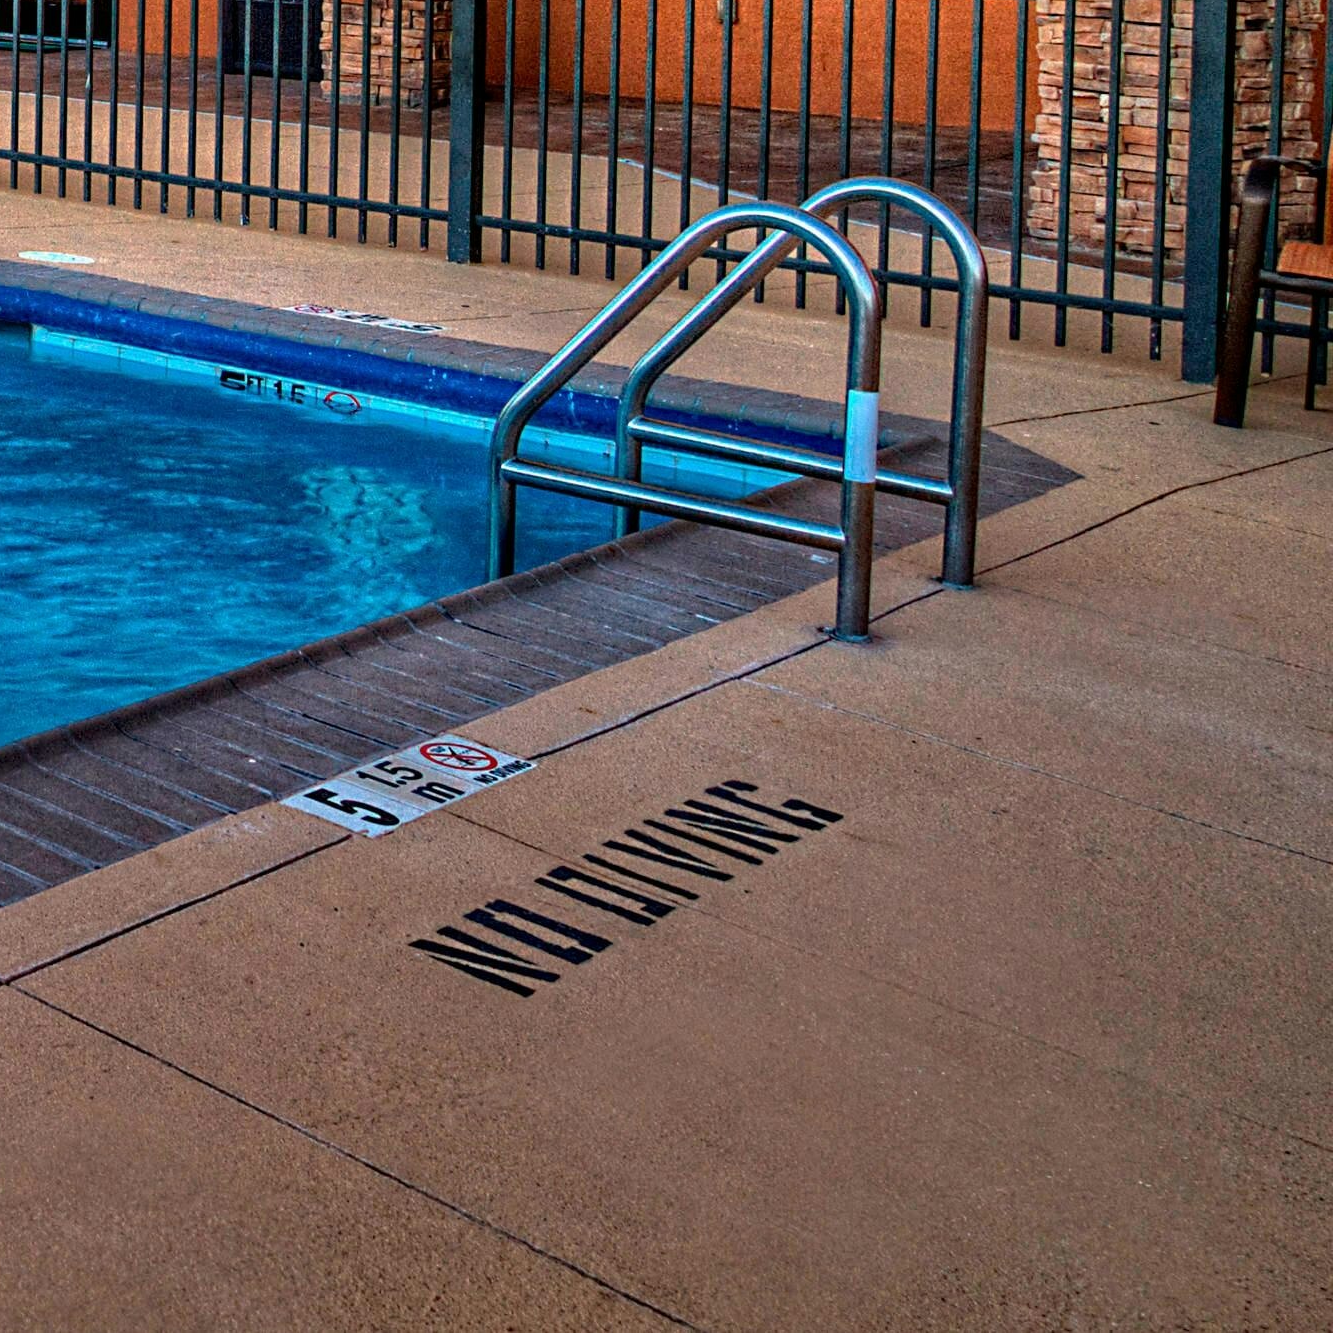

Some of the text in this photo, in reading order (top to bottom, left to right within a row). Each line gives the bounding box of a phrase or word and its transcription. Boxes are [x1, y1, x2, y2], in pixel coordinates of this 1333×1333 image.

[355, 760, 424, 789] 1.5
[473, 760, 532, 785] NO DIVING
[411, 781, 466, 803] m
[303, 788, 401, 826] 5
[408, 780, 845, 998] NO DIVING
